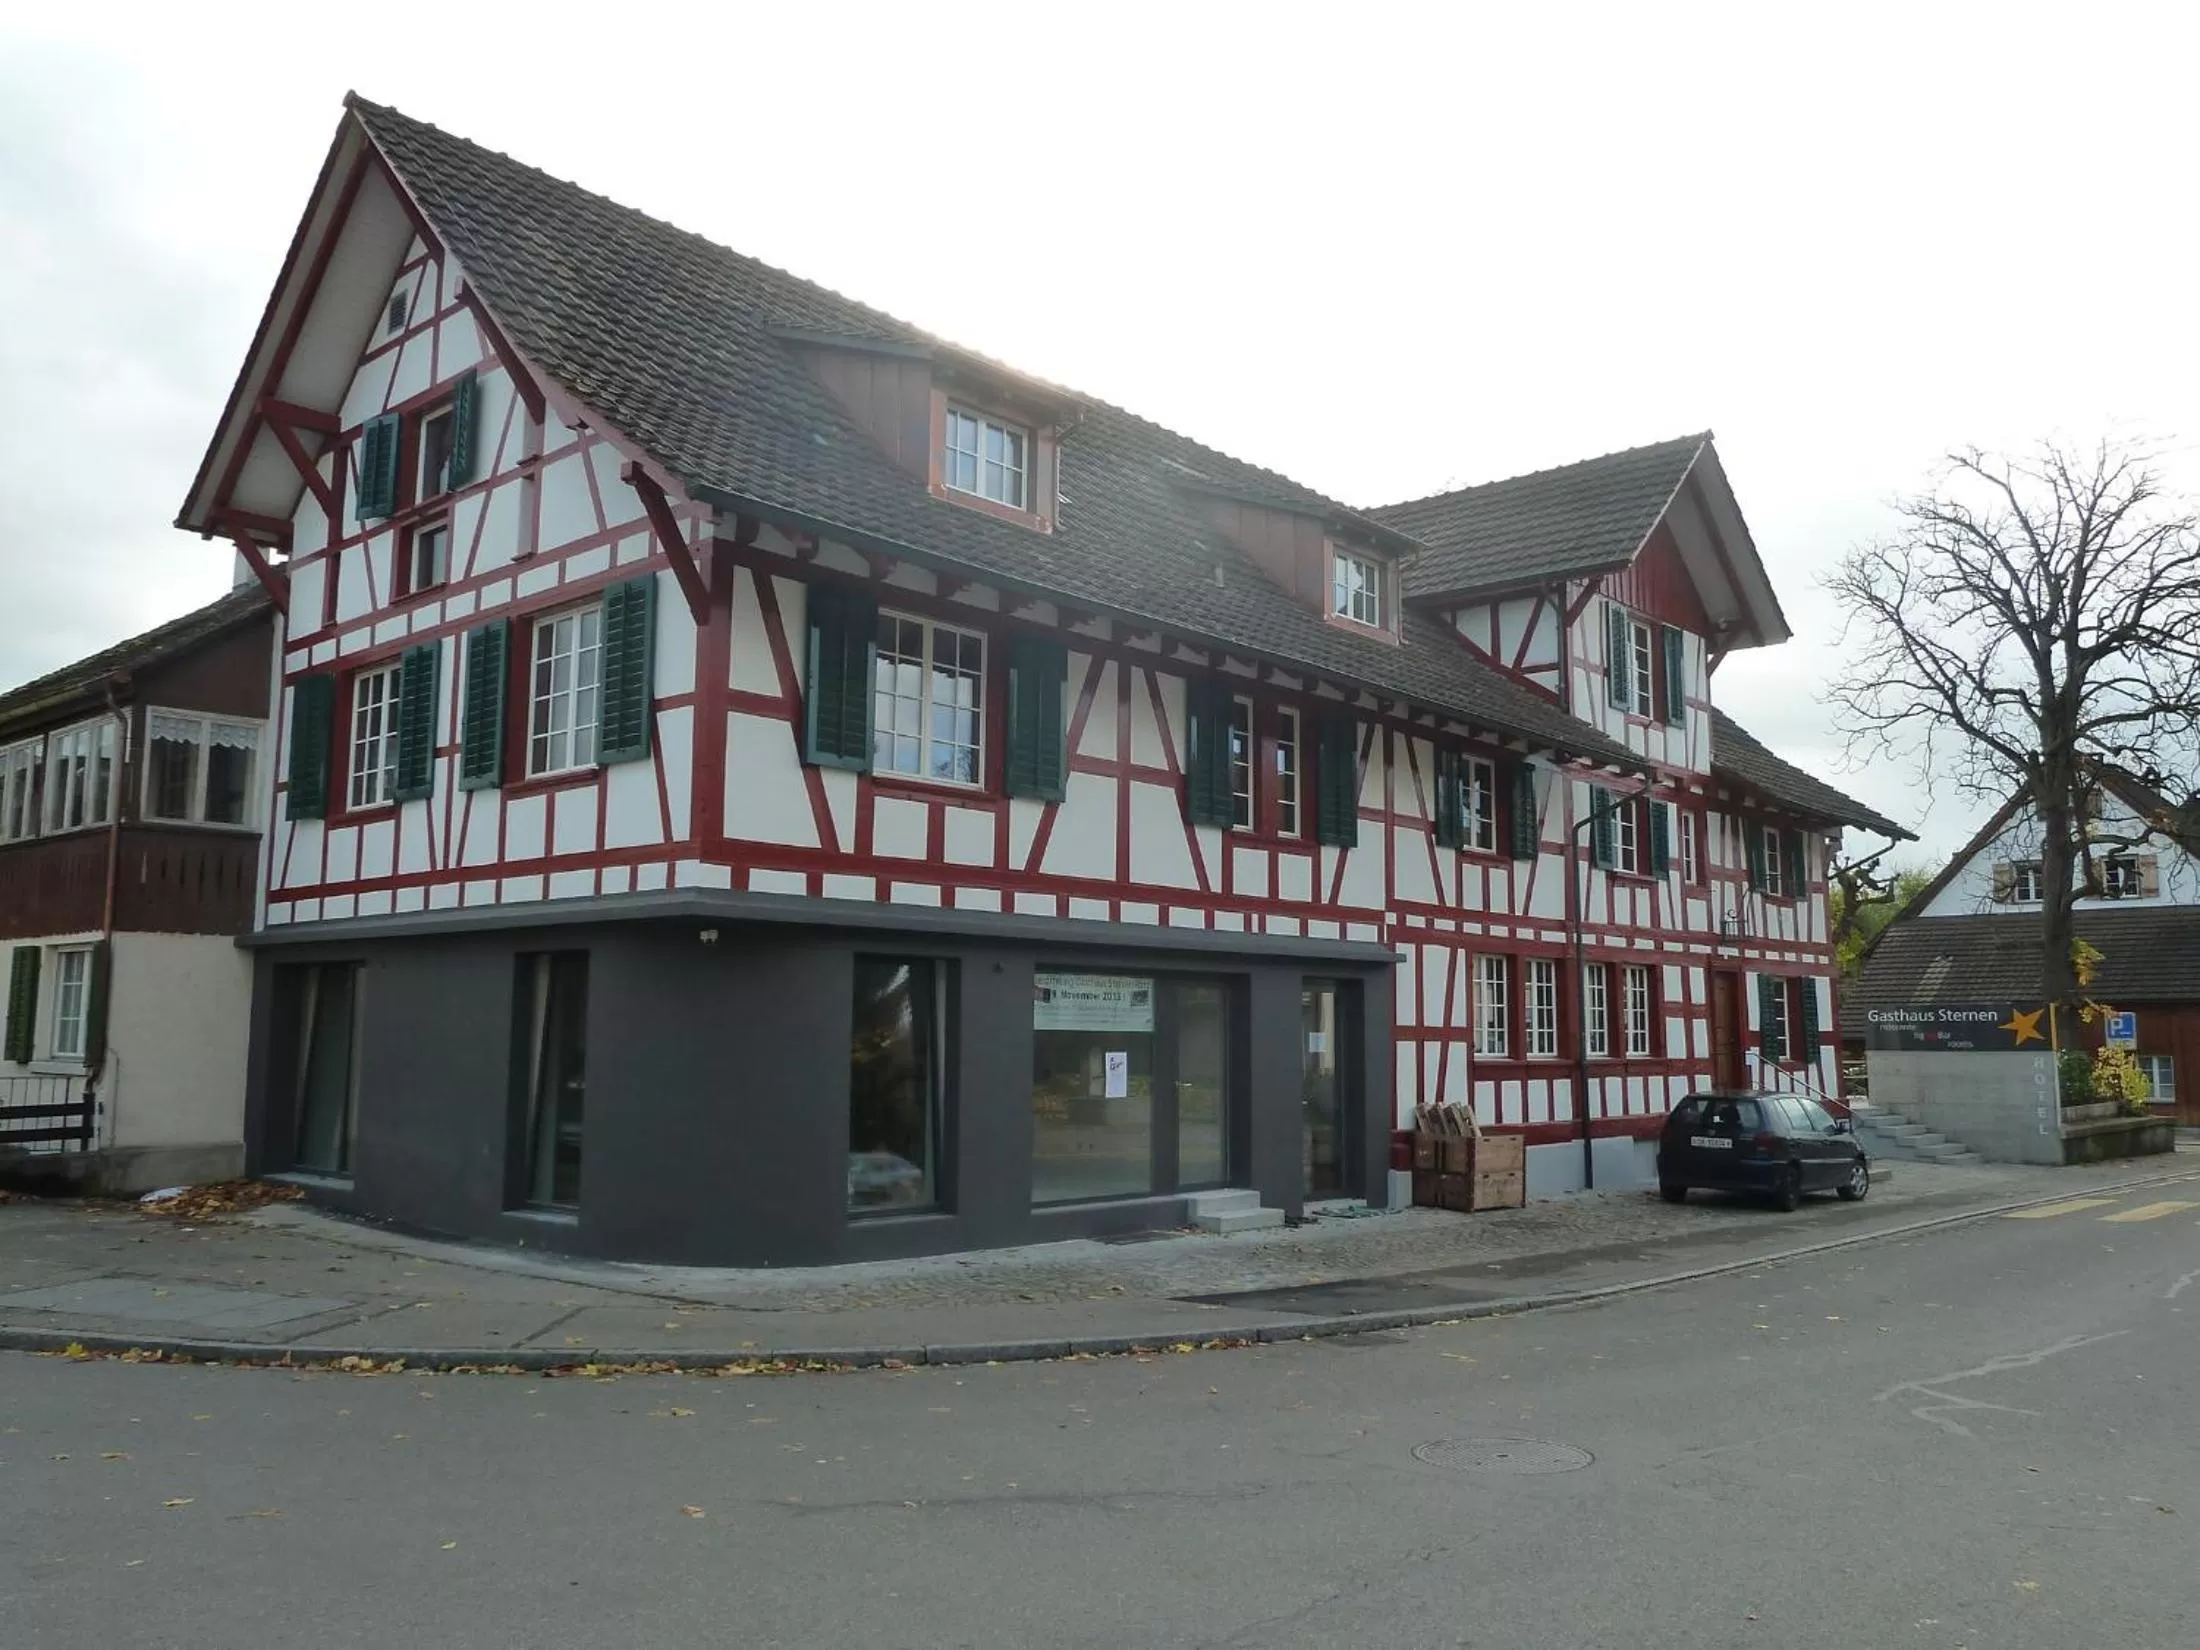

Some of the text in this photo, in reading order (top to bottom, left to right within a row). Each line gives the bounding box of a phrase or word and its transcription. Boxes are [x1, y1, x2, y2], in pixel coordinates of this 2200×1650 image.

[1867, 1008, 1998, 1022] Gasthaus Sternen
[2110, 1018, 2124, 1037] P
[2034, 1056, 2048, 1135] HOTEL
